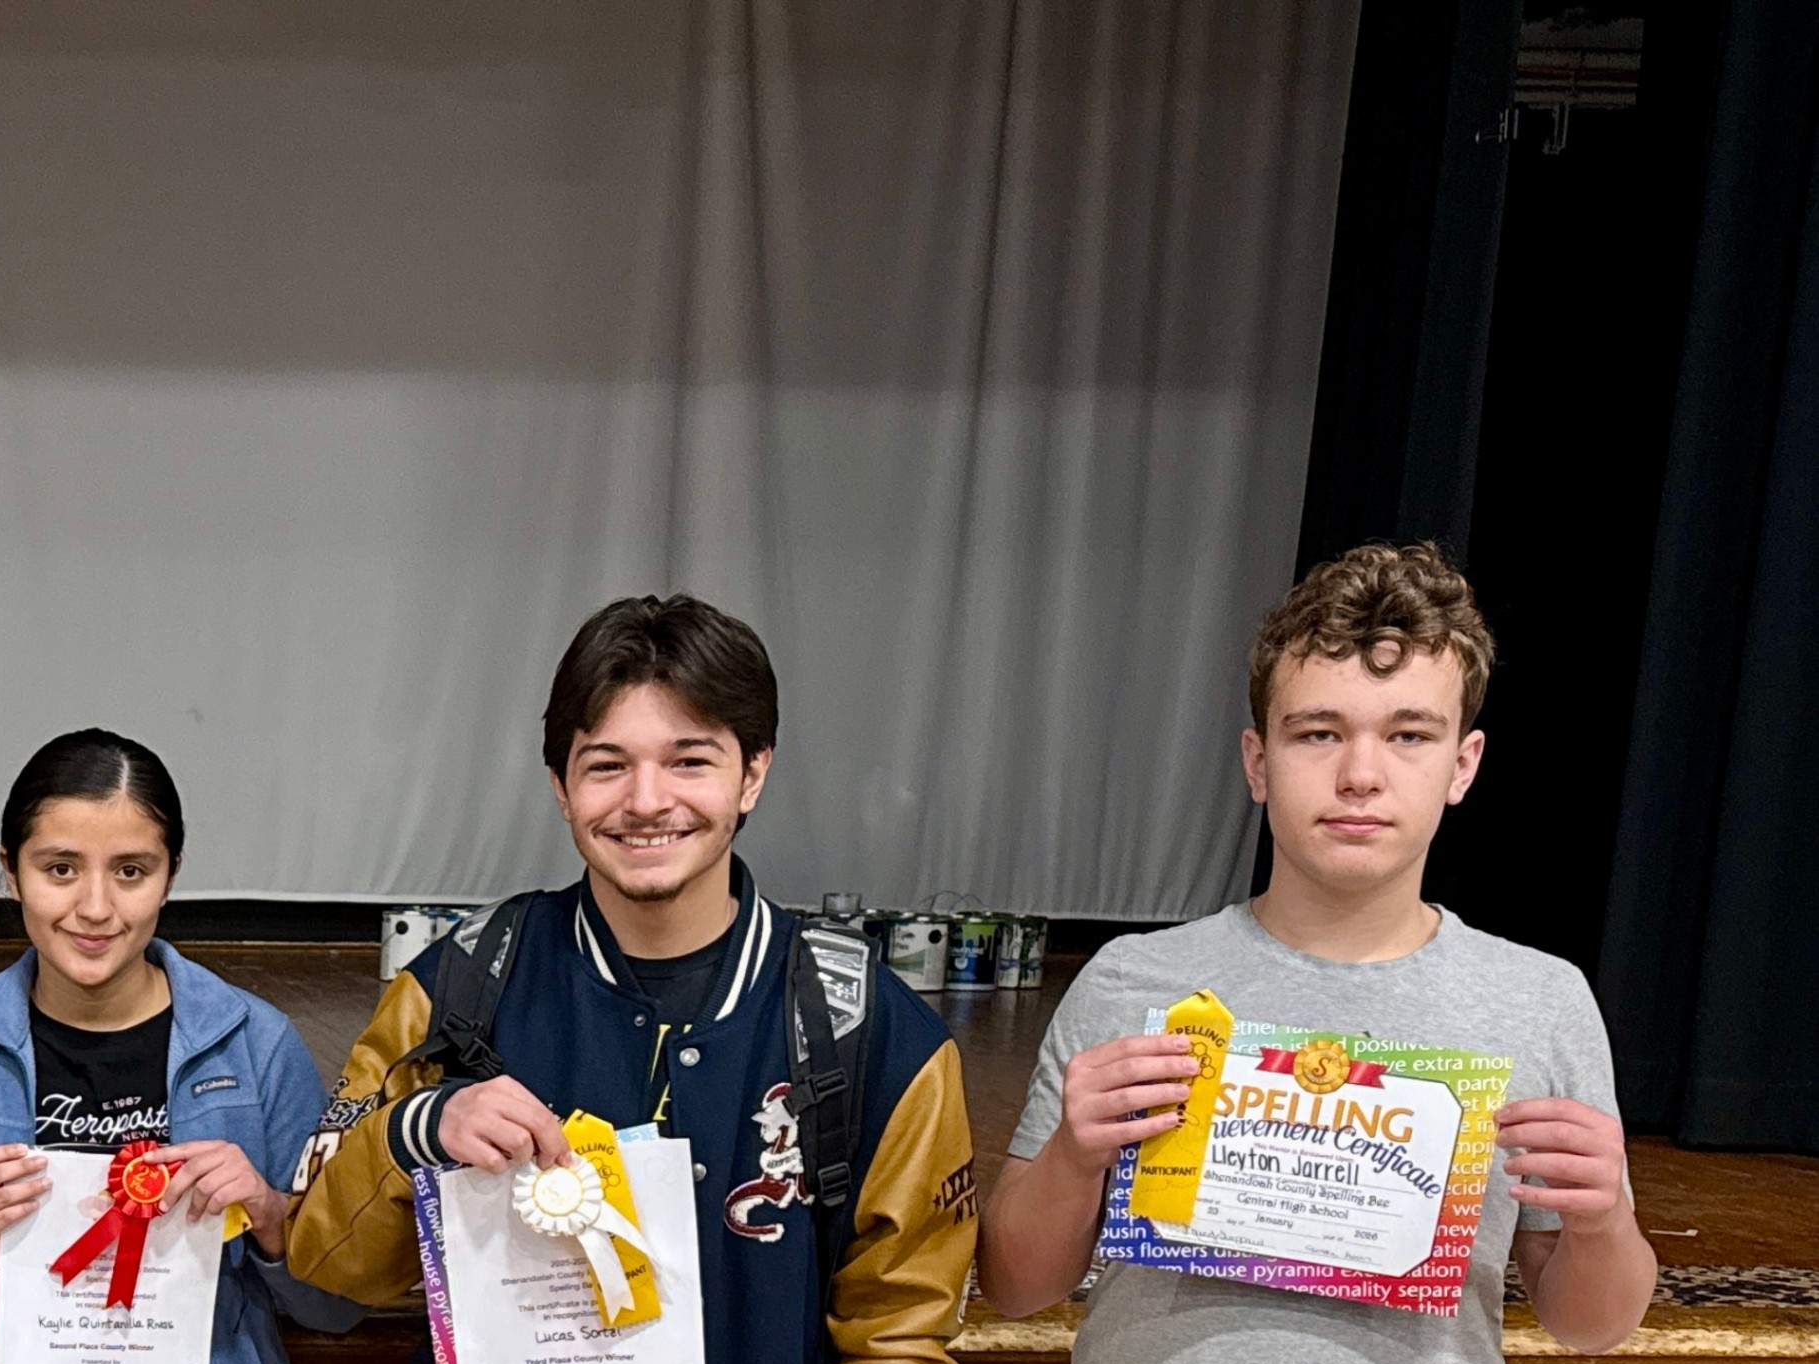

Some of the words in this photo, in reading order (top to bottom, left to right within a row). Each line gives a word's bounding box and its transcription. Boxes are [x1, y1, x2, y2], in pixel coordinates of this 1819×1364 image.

[1413, 1056, 1463, 1073] extra
[34, 1093, 168, 1144] Aeropost
[1214, 1083, 1415, 1143] SPELLING
[1141, 1166, 1198, 1177] PARTICIPANT
[1333, 1125, 1441, 1199] Certificate
[1276, 1181, 1316, 1198] County
[1319, 1187, 1365, 1207] Spelling
[1237, 1190, 1278, 1208] Central
[1281, 1199, 1306, 1214] High
[1309, 1201, 1349, 1220] School
[1140, 1241, 1208, 1259] flowers
[1190, 1261, 1247, 1278] house
[1289, 1282, 1392, 1304] personality
[38, 1314, 74, 1334] Kaylie
[78, 1315, 144, 1331] Quintanilla
[534, 1330, 576, 1345] Lucas
